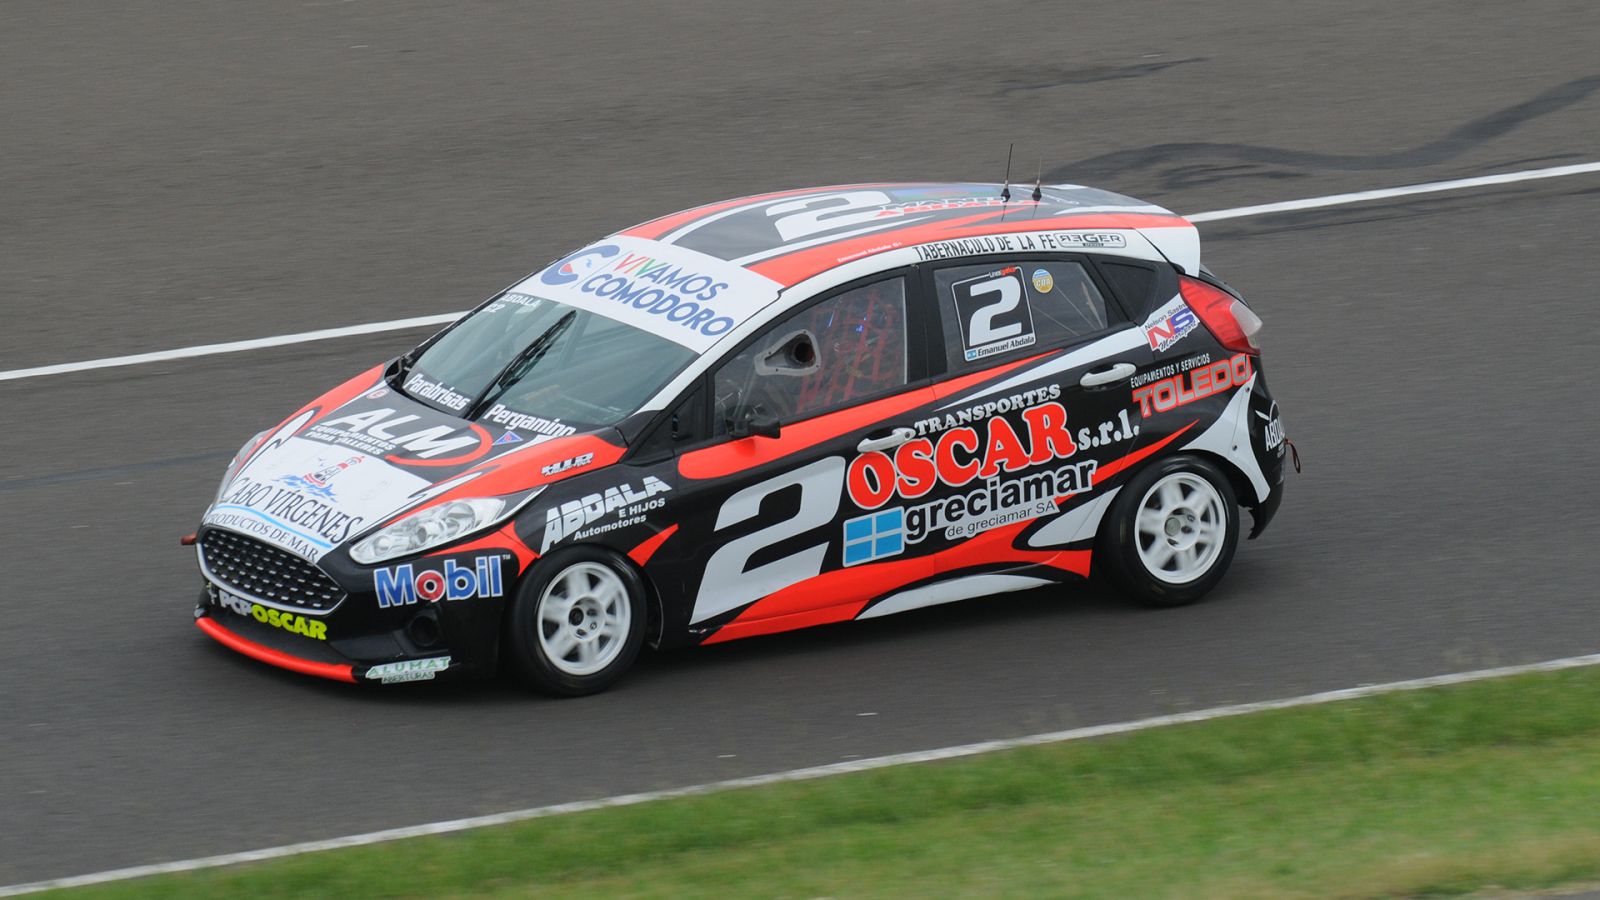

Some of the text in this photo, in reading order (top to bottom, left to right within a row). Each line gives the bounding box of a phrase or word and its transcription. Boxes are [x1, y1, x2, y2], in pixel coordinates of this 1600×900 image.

[765, 190, 892, 242] 2
[911, 235, 996, 262] TABERNACULO
[997, 235, 1014, 251] DE
[1016, 235, 1035, 250] LA
[1038, 233, 1057, 249] FE
[613, 253, 729, 301] VIVAMOS
[581, 273, 735, 337] COMODORO
[969, 275, 1022, 347] 2
[977, 335, 1035, 357] Emanuel Abdala
[1175, 363, 1181, 376] Y
[1181, 353, 1211, 372] SERVICIOS
[402, 373, 471, 411] Parabrisas
[914, 383, 1062, 437] TRANSPORTES
[1131, 352, 1252, 419] TOLEDO
[320, 407, 481, 460] ALM
[846, 401, 1078, 510] OSCAR
[540, 475, 673, 557] ABDALA
[573, 514, 647, 541] Automotores
[618, 497, 666, 519] E HIJOS
[904, 461, 1096, 543] greciamar
[947, 500, 1057, 538] de greciamar SA
[204, 512, 320, 562] PRODUCTOS DE MAR
[688, 455, 847, 626] 2
[373, 555, 504, 609] Mobil
[367, 656, 450, 677] ALUMAT
